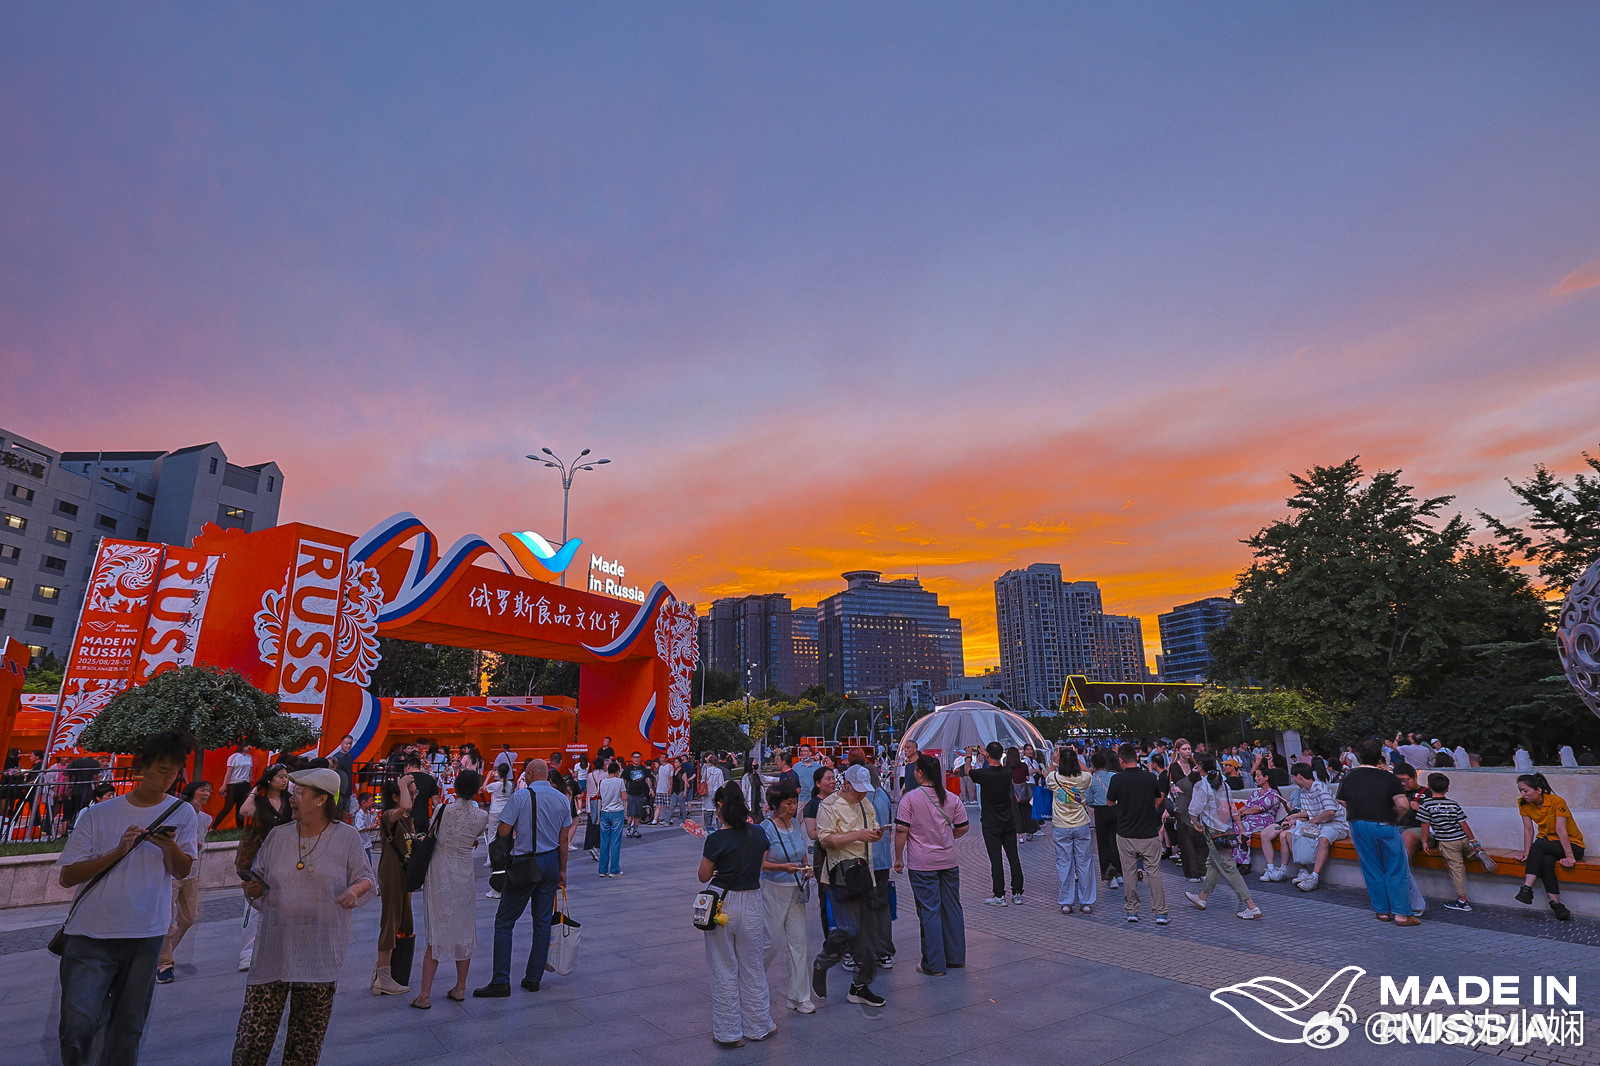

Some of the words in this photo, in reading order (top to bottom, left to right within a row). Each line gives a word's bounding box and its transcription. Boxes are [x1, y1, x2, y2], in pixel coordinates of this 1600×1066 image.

[590, 553, 625, 577] Made
[589, 574, 603, 592] in
[605, 578, 645, 603] Russia
[177, 562, 214, 666] 俄罗斯食
[468, 583, 621, 639] 俄罗斯食品文化节
[79, 646, 132, 657] RUSSIA
[82, 635, 120, 646] MADE
[122, 637, 137, 646] IN
